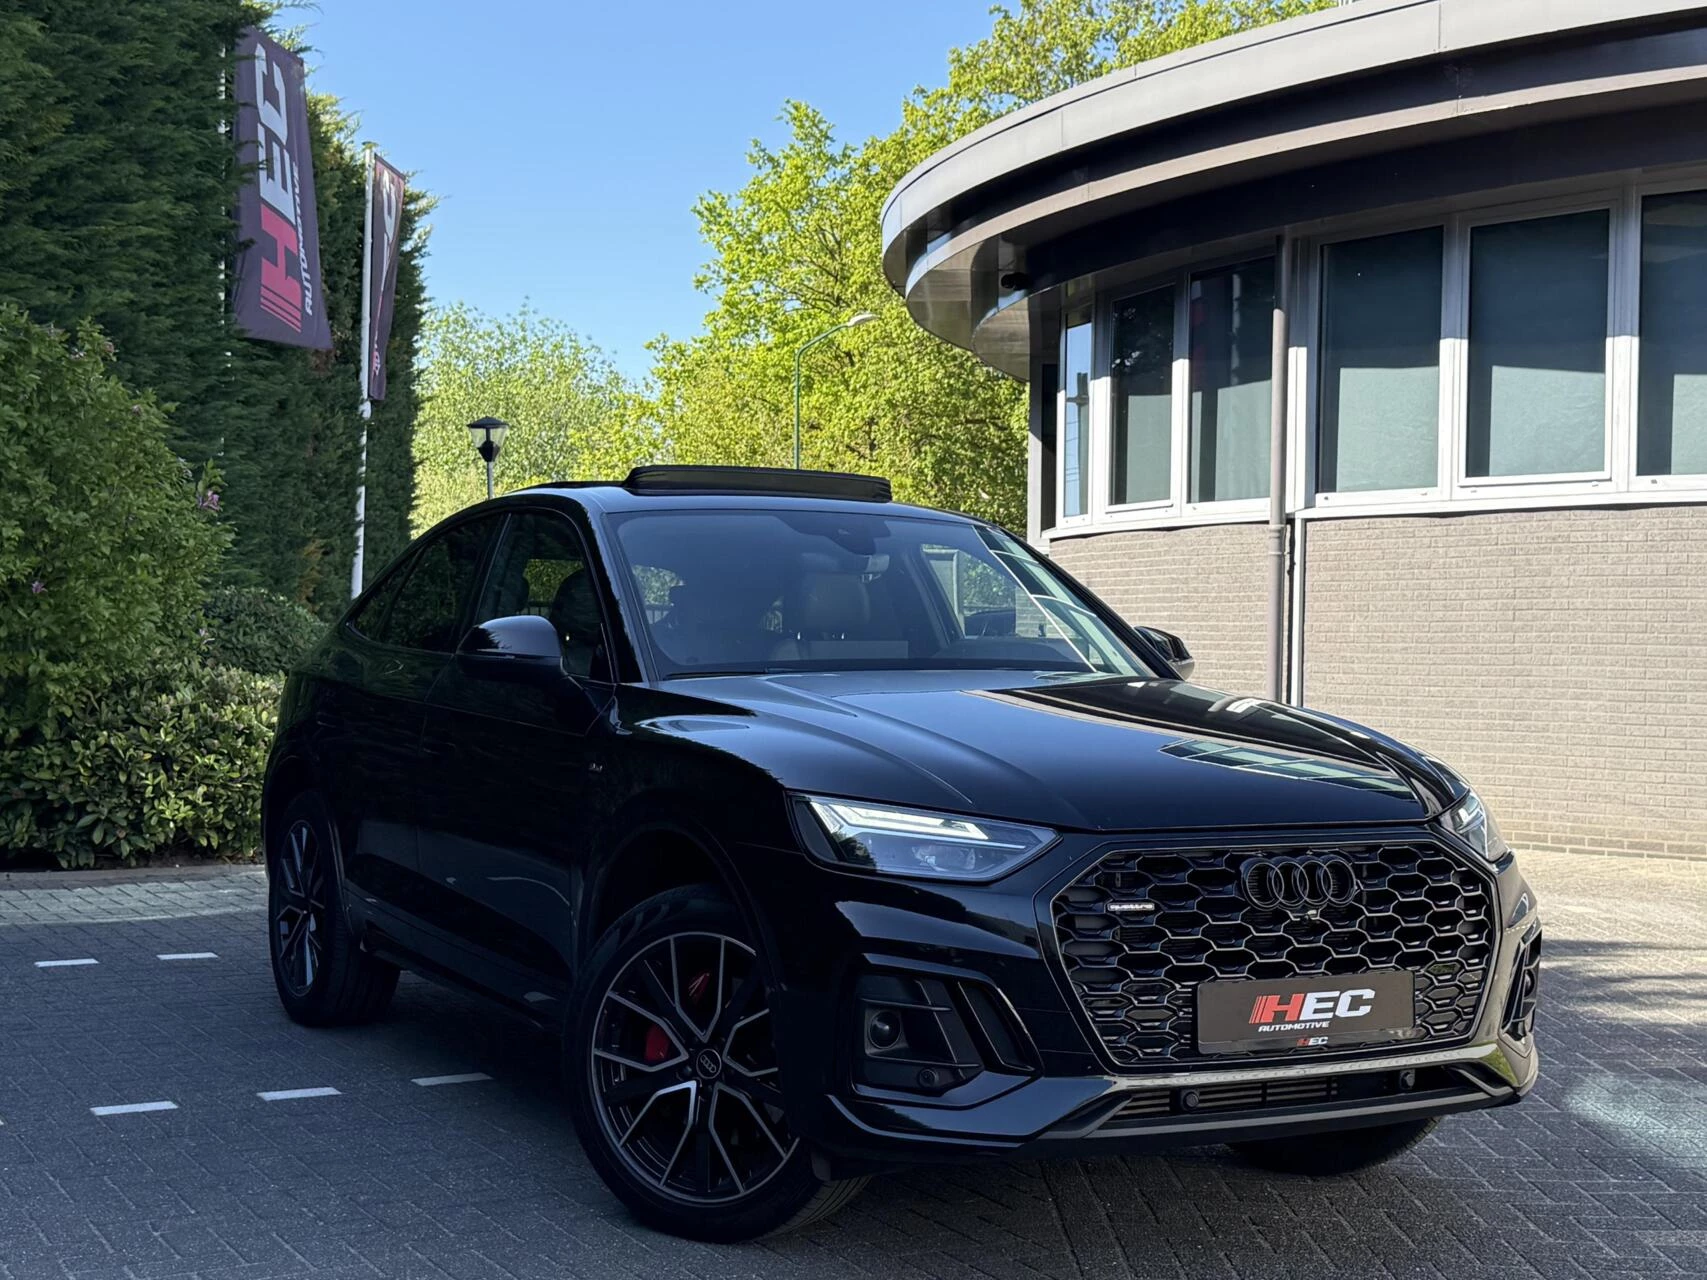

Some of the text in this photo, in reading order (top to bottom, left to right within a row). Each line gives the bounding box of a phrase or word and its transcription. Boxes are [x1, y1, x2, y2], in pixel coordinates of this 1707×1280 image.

[255, 43, 302, 332] HEC
[293, 162, 312, 315] AUTOMOTIVE
[1249, 988, 1376, 1024] HEC
[1258, 1021, 1331, 1033] AUTOMOTIVE
[1296, 1036, 1329, 1047] HEC
